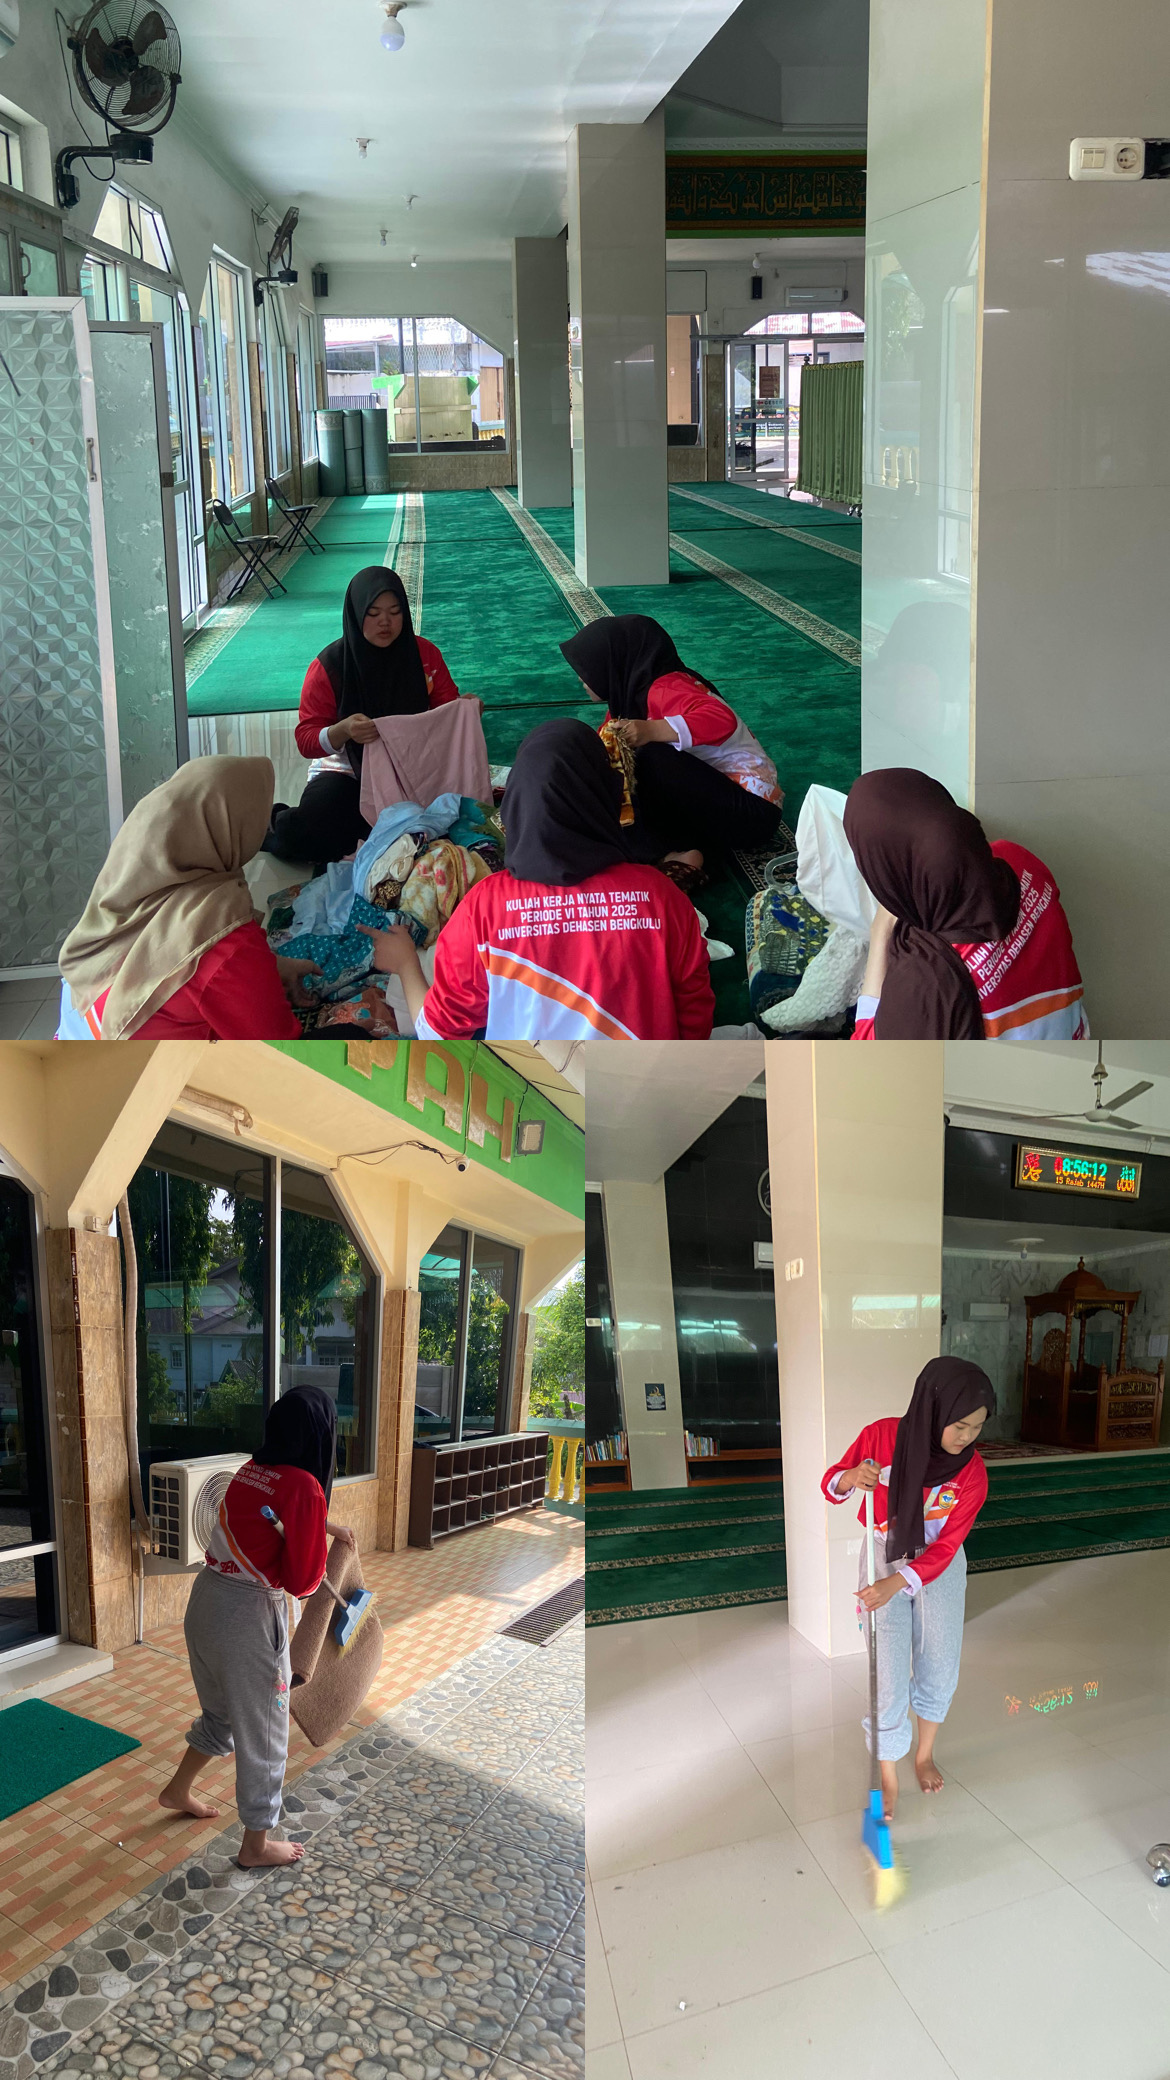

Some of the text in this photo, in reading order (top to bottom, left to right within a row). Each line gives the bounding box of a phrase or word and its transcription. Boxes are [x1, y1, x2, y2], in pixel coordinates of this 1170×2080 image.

[506, 890, 650, 912] KULIAH KERJA NYATA TEMATIK
[520, 904, 638, 924] PERIODE VI TAHUN 2025
[497, 918, 661, 941] UNIVERSITAS DEHASEN BENGKULU
[976, 939, 1005, 981] PERIODE
[1023, 887, 1039, 913] 2025
[978, 957, 1012, 1000] IVERSITAS
[1009, 918, 1035, 960] DEHASEN
[1029, 881, 1053, 923] BENGKULU
[1054, 1156, 1107, 1181] 08:56:12
[1055, 1176, 1105, 1190] 15 Rajab 1447H
